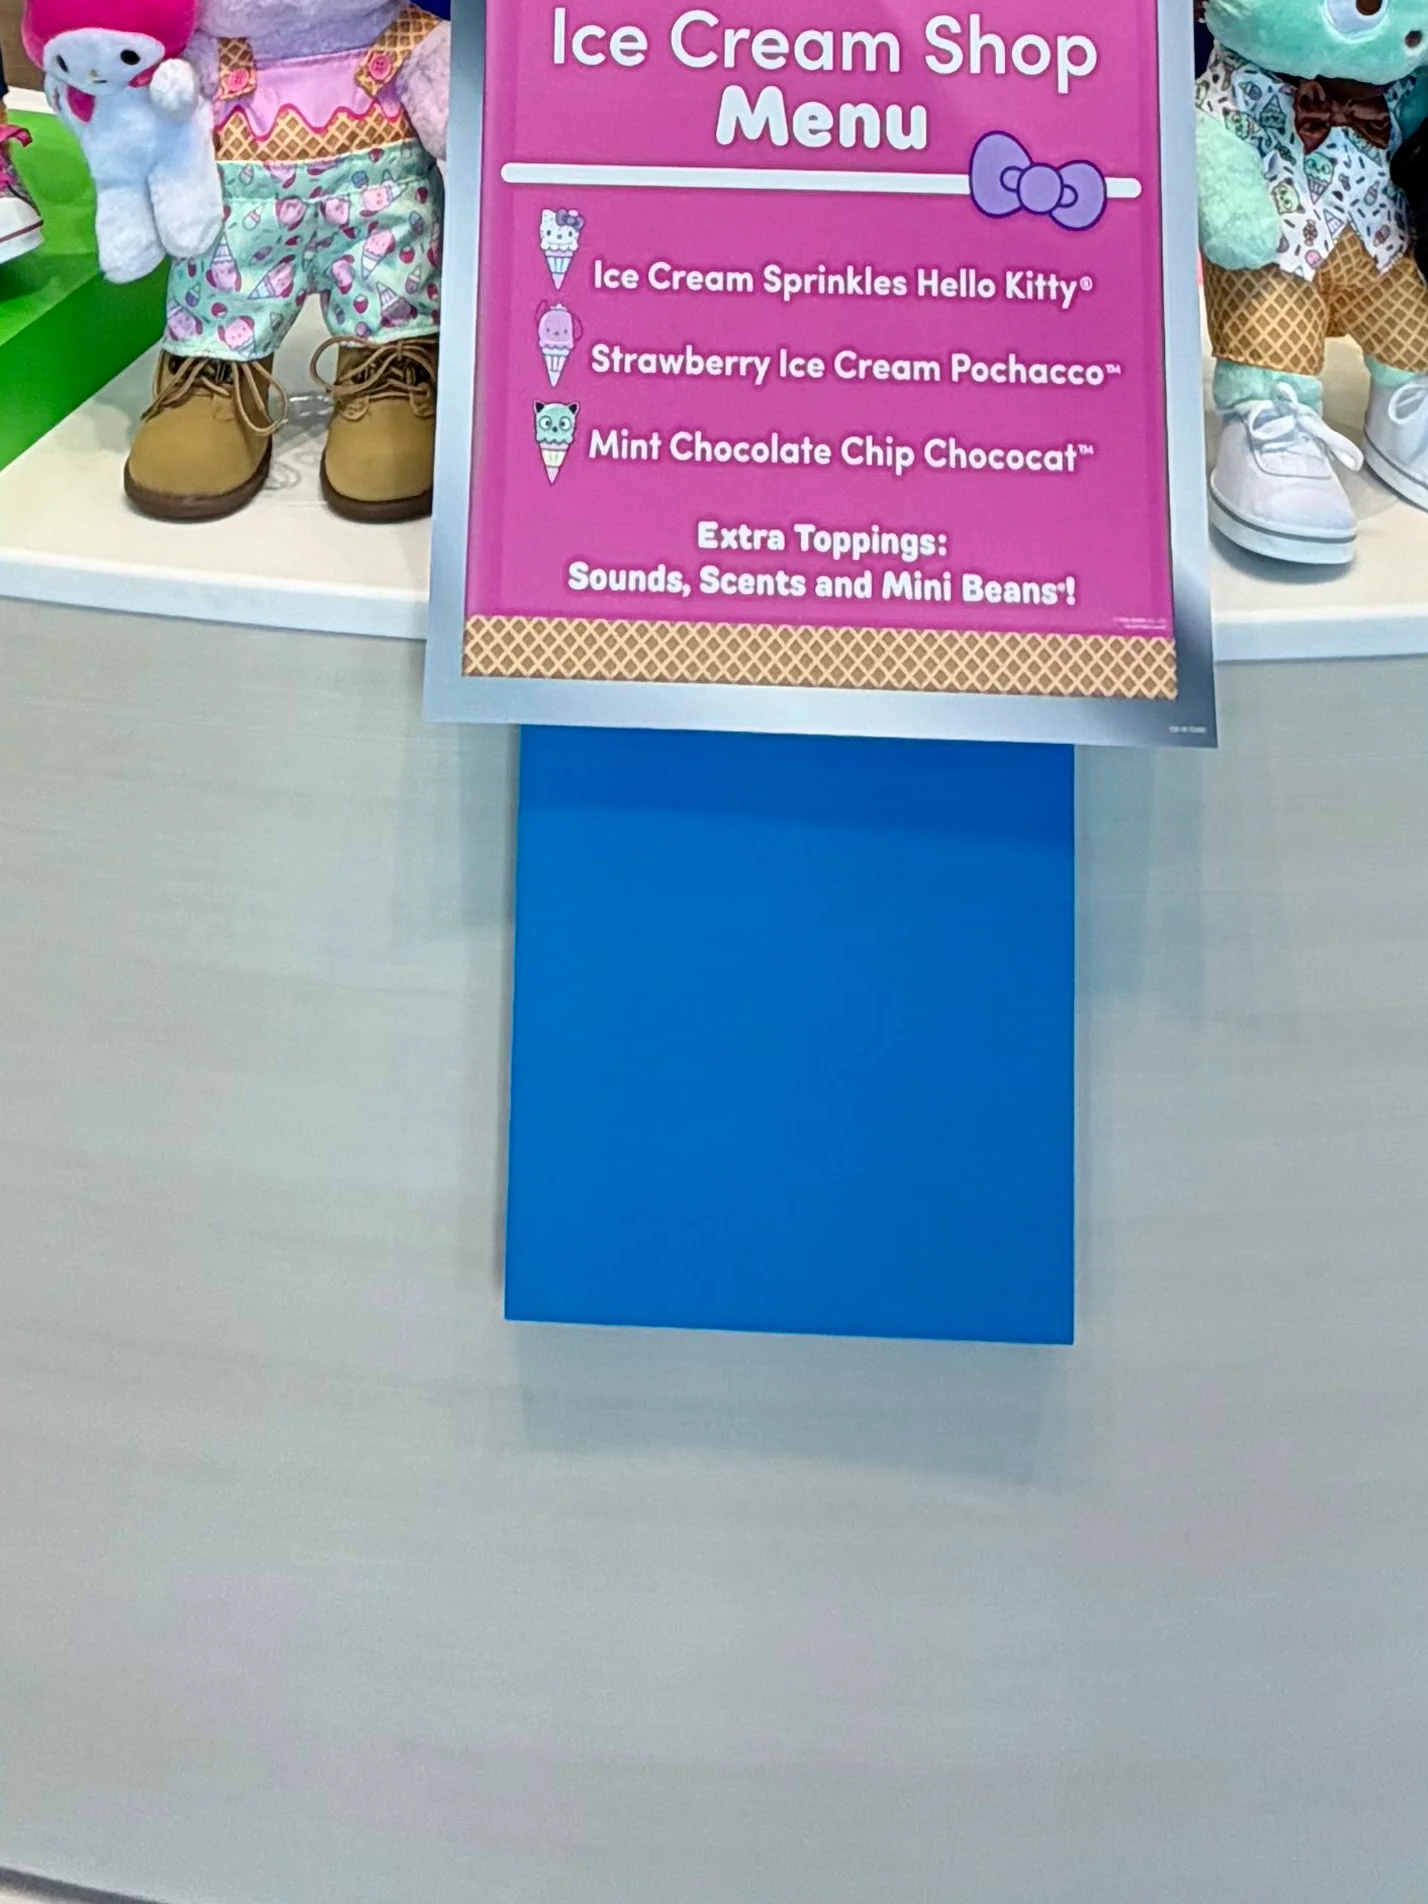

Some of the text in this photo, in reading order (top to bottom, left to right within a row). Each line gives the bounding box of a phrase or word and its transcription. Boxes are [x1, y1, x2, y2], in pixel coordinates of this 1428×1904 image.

[553, 7, 1097, 94] Ice Cream Shop
[716, 85, 927, 150] Menu
[594, 260, 639, 289] Ice
[648, 261, 754, 292] Cream
[763, 264, 908, 302] Sprinkles
[917, 268, 996, 298] Hello
[591, 343, 771, 385] Strawberry
[779, 348, 825, 378] Ice
[834, 350, 940, 382] Cream
[589, 428, 662, 460] Mint
[670, 430, 832, 464] Chocolate
[841, 435, 915, 476] Chip
[697, 520, 948, 562] Extra Toppings:
[568, 561, 691, 598] Sounds,
[699, 565, 806, 596] Scents
[815, 570, 872, 599] and
[882, 571, 951, 602] Mini
